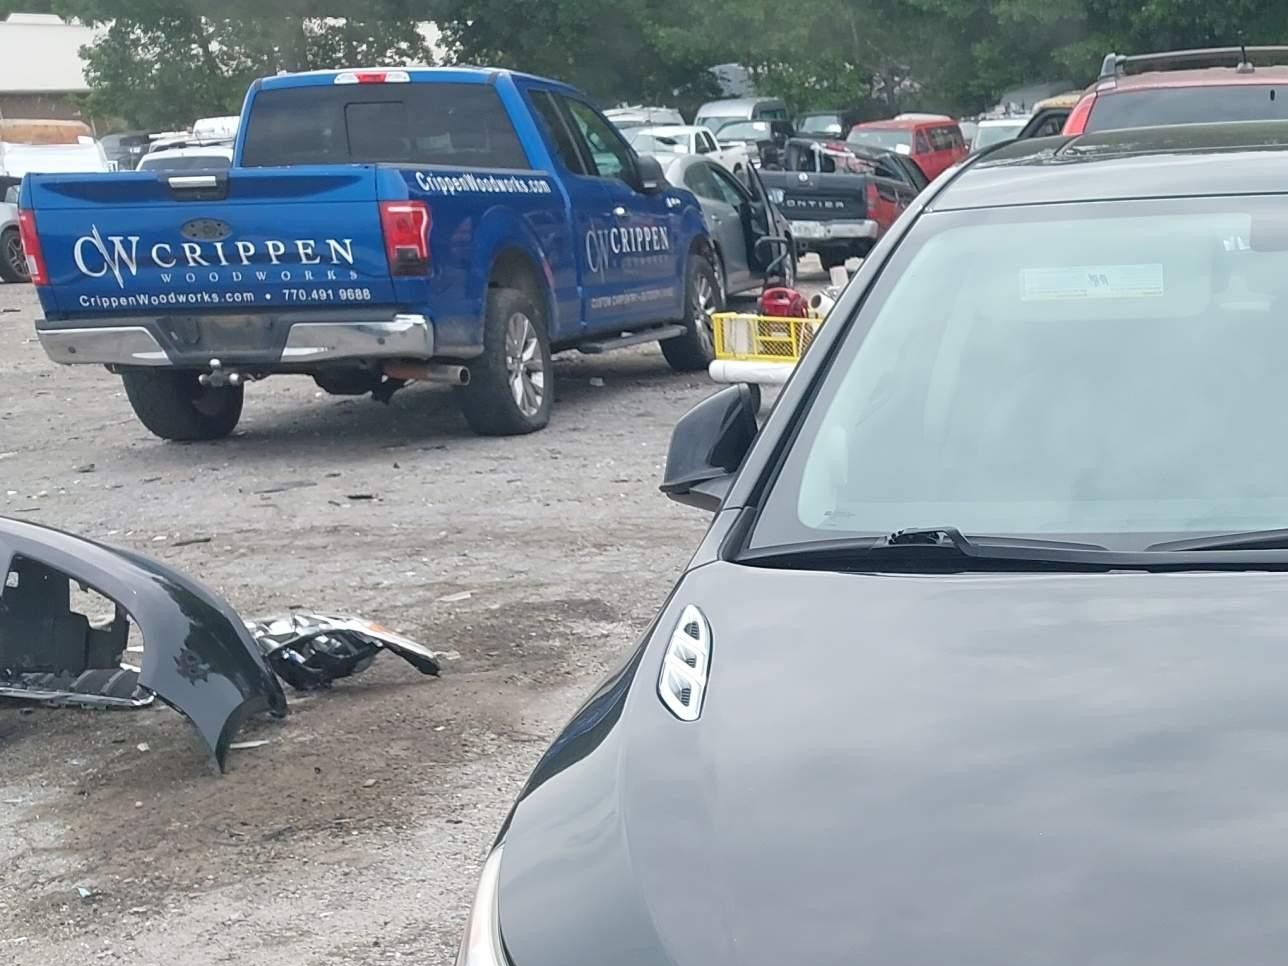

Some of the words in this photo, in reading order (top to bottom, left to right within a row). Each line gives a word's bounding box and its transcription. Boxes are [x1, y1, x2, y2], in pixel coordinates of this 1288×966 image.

[415, 171, 551, 196] CrippenWoodworks.com
[785, 199, 845, 209] ONTIER
[610, 226, 669, 254] CRIPPEN
[151, 238, 354, 268] CRIPPEN
[160, 270, 358, 284] WOODWORKS
[79, 291, 255, 308] CrippenWoodworks.com
[282, 288, 334, 301] 770.491
